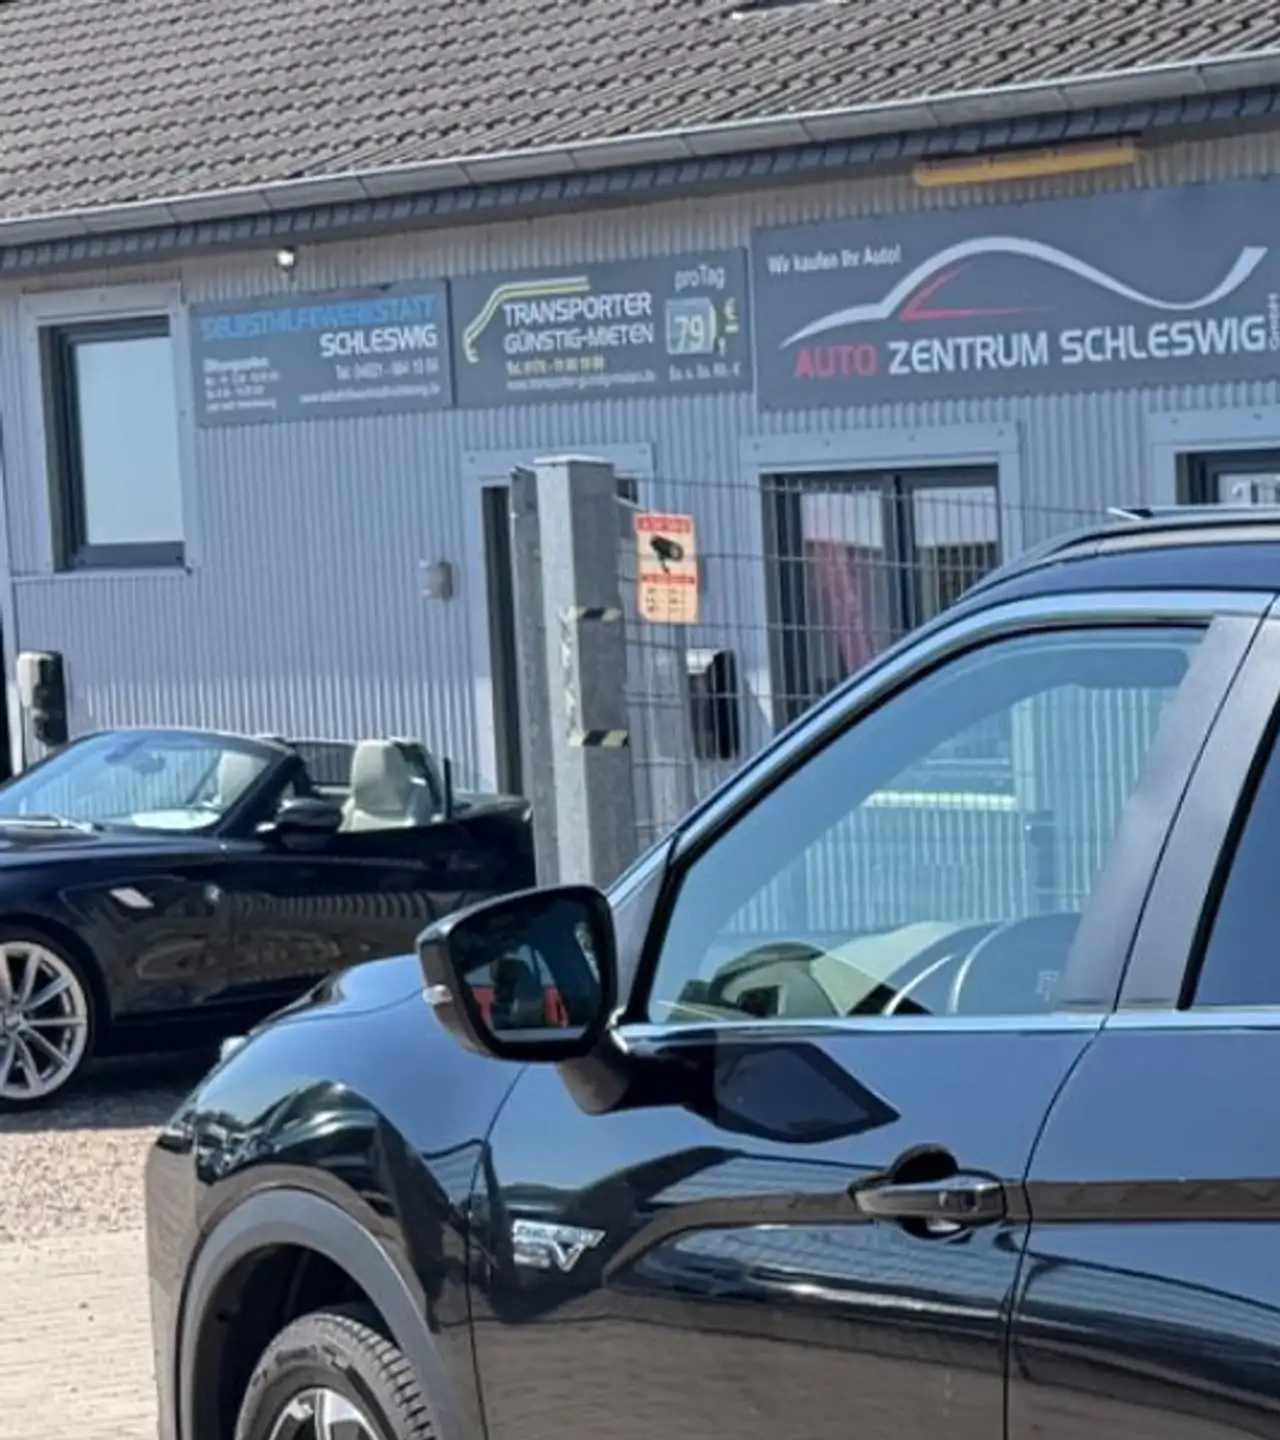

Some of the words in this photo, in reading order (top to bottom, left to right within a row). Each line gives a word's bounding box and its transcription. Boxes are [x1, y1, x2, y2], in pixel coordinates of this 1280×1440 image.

[502, 292, 653, 327] TRANSPORTER
[318, 322, 439, 359] SCHLESWIG
[503, 322, 655, 355] GÜNSTIG-MIETEN
[674, 313, 705, 353] 79
[794, 343, 879, 380] AUTO
[887, 330, 1050, 376] ZENTRUM
[1059, 315, 1267, 364] SCHLESWIG
